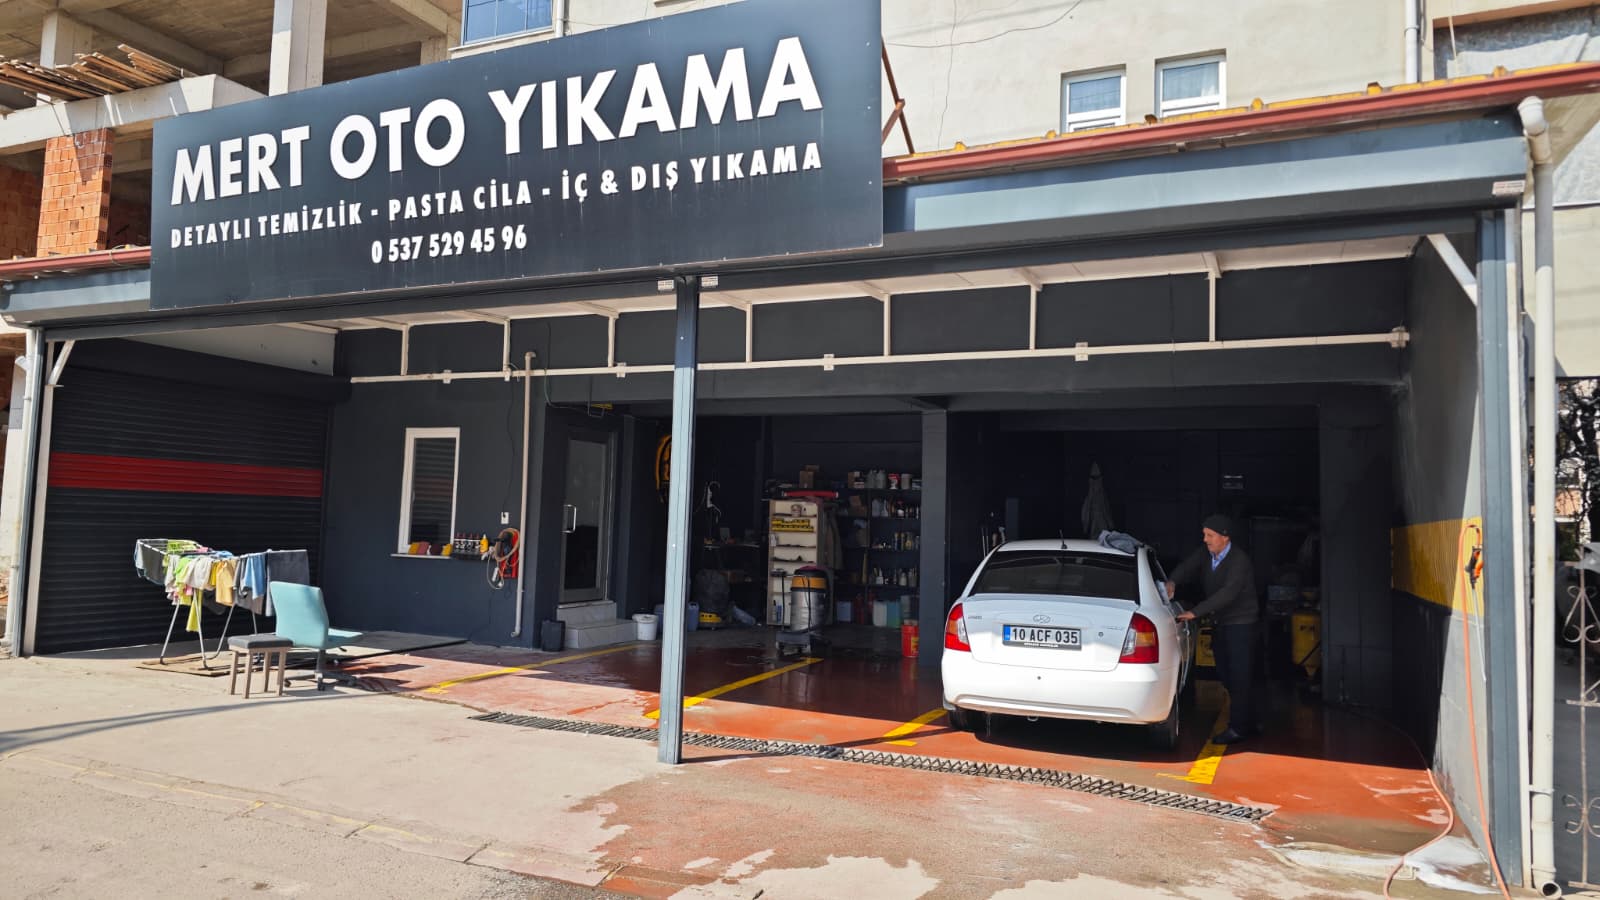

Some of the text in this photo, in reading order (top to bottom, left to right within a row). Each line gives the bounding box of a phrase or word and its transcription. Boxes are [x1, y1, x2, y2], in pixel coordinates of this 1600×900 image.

[171, 37, 823, 206] MERT OTO YIKAMA
[171, 218, 251, 249] DETAYLI
[258, 203, 362, 237] TEMİZLİK
[388, 189, 464, 221] PASTA
[473, 179, 532, 210] CİLA
[562, 169, 588, 203] İÇ
[600, 169, 619, 195] &
[631, 160, 679, 191] DIŞ
[690, 142, 822, 184] YIKAMA
[371, 224, 527, 264] 0 537 529 45 96
[1012, 628, 1078, 644] 10 ACF 035
